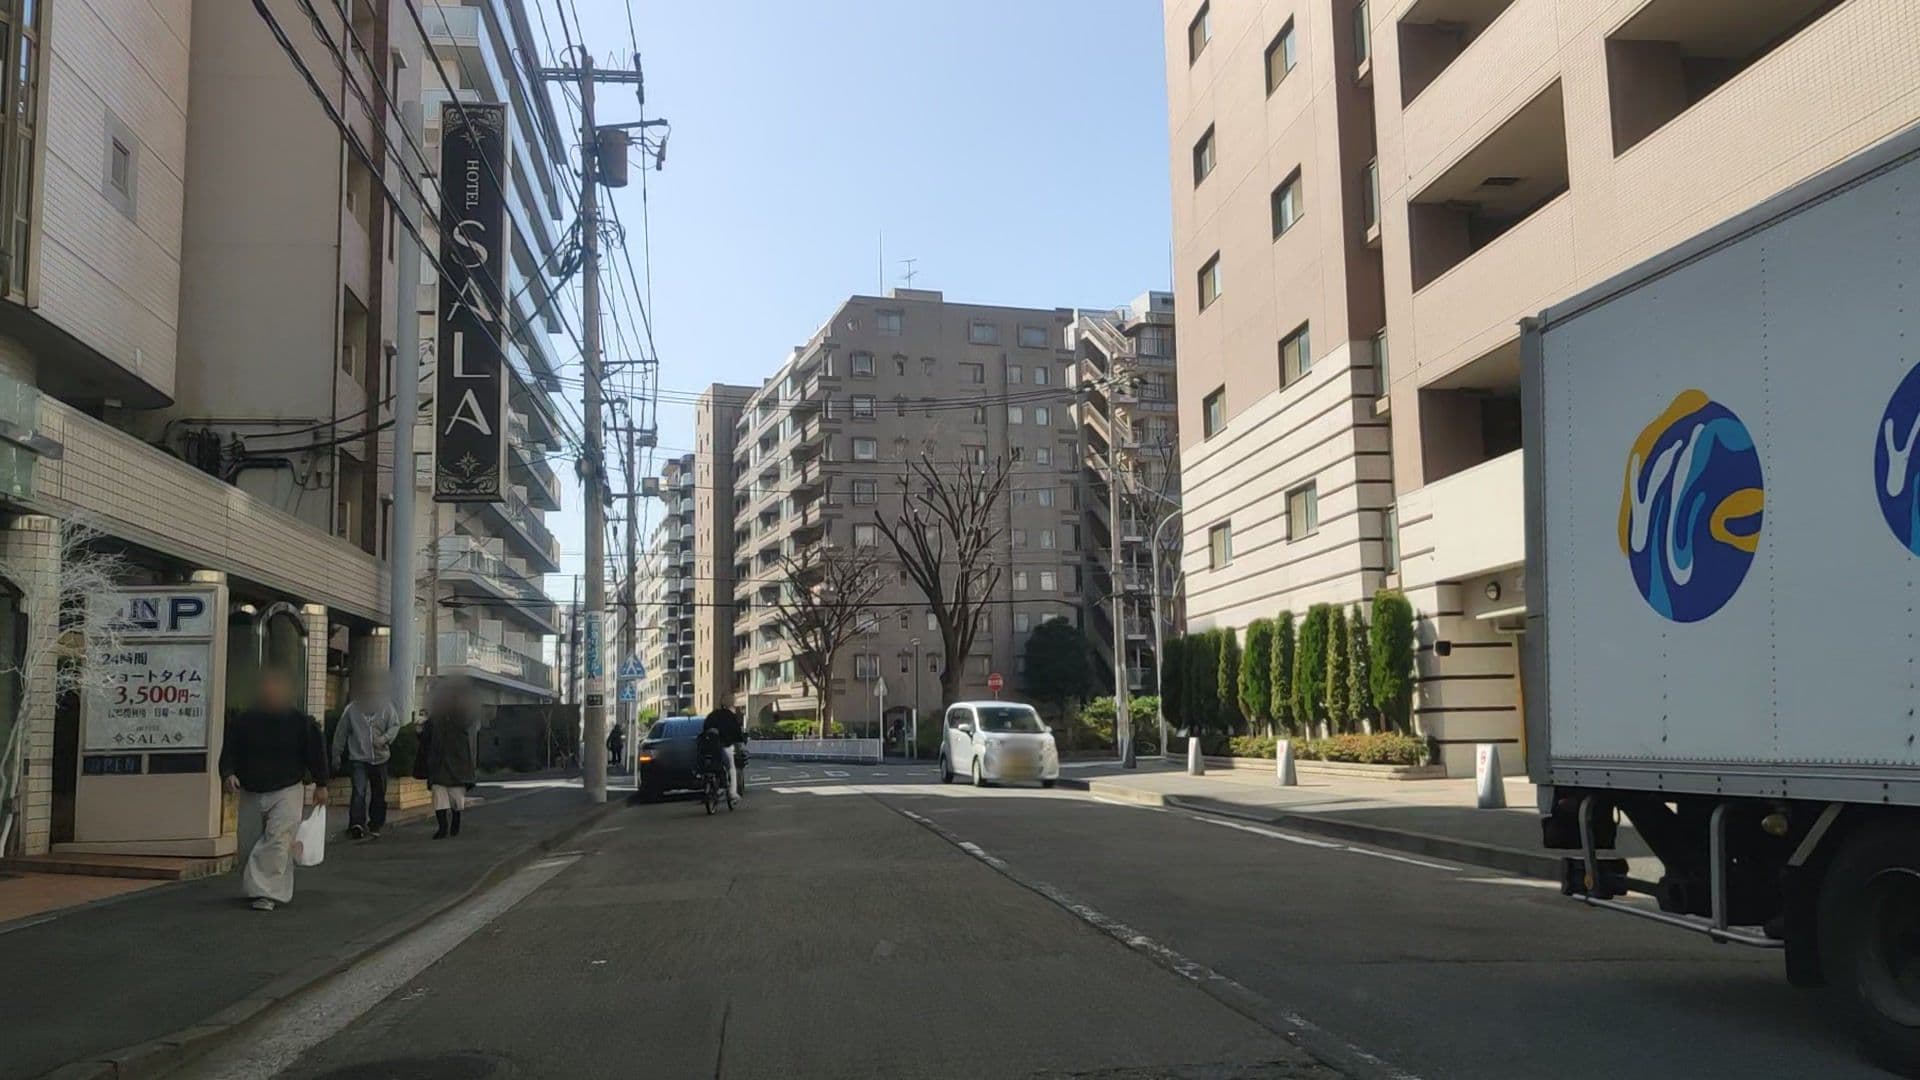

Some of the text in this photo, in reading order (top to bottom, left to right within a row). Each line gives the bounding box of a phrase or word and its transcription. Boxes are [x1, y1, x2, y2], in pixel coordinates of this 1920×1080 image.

[466, 160, 479, 210] HOTEL
[445, 220, 493, 436] SALA
[166, 596, 204, 632] P
[126, 733, 172, 745] SALA
